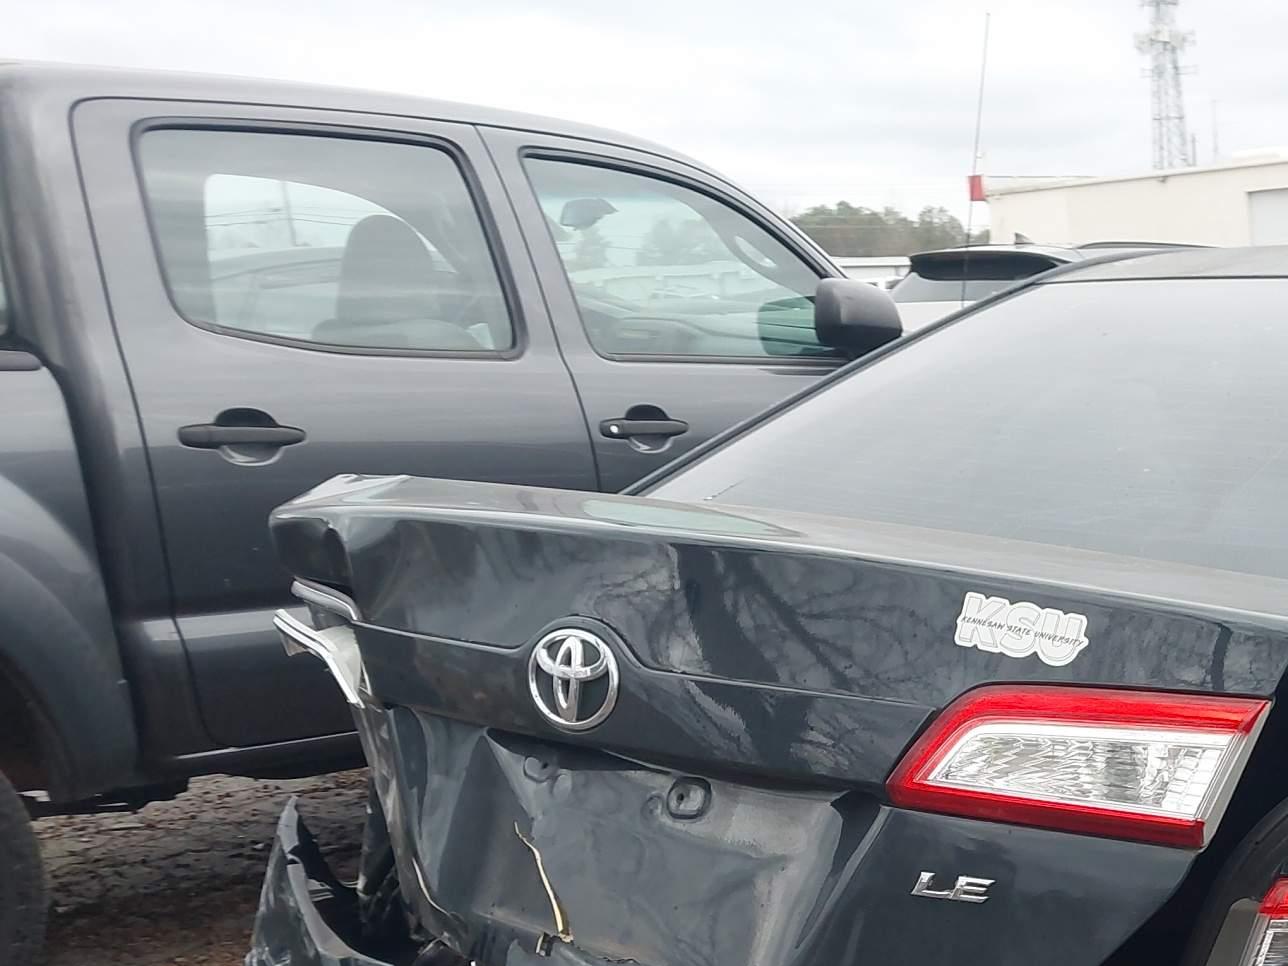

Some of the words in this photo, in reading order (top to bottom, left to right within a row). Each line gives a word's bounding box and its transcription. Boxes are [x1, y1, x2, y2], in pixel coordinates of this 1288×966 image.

[957, 594, 1084, 664] KSU
[962, 616, 1004, 630] KENNESAW
[1007, 625, 1031, 636] STATE
[1034, 631, 1083, 647] UNIVERSITY
[911, 871, 996, 904] LE
